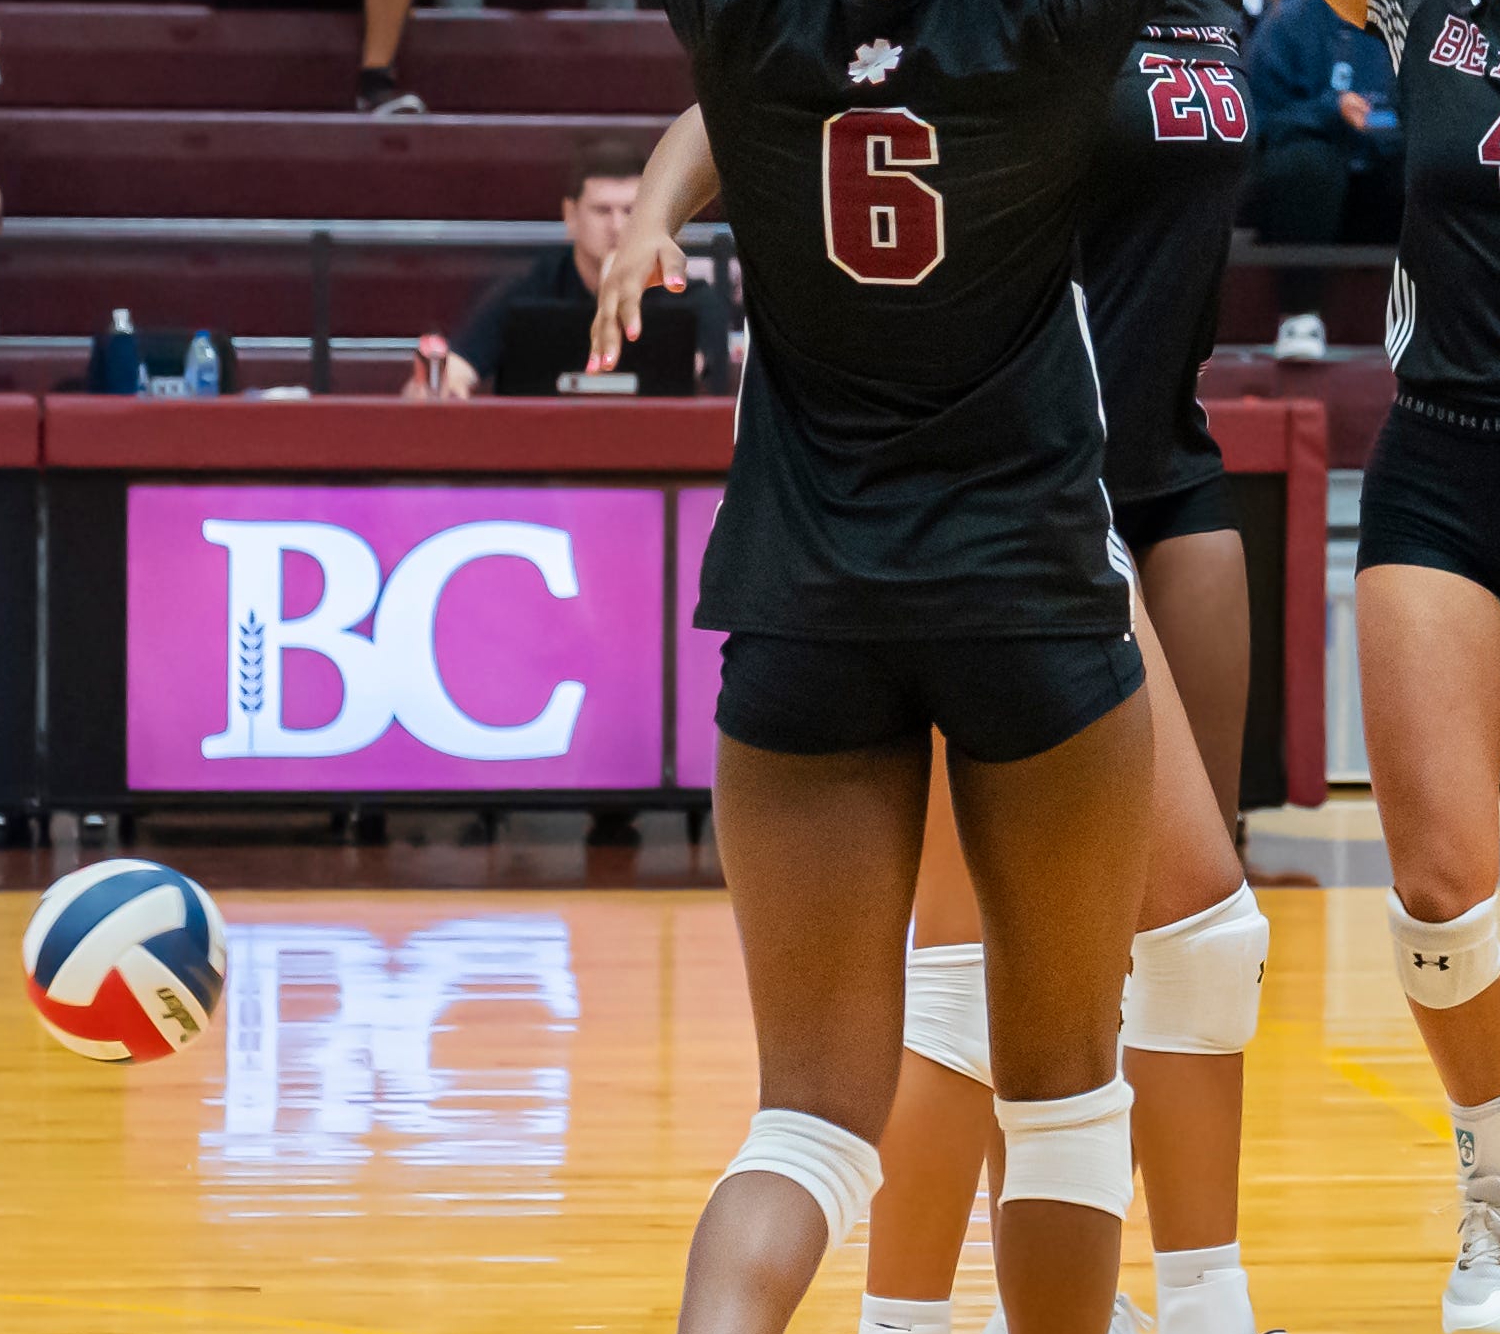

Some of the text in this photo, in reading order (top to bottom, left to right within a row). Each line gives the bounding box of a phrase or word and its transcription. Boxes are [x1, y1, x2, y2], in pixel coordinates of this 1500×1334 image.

[1139, 53, 1248, 142] 26
[822, 107, 945, 285] 6
[200, 518, 586, 762] BC
